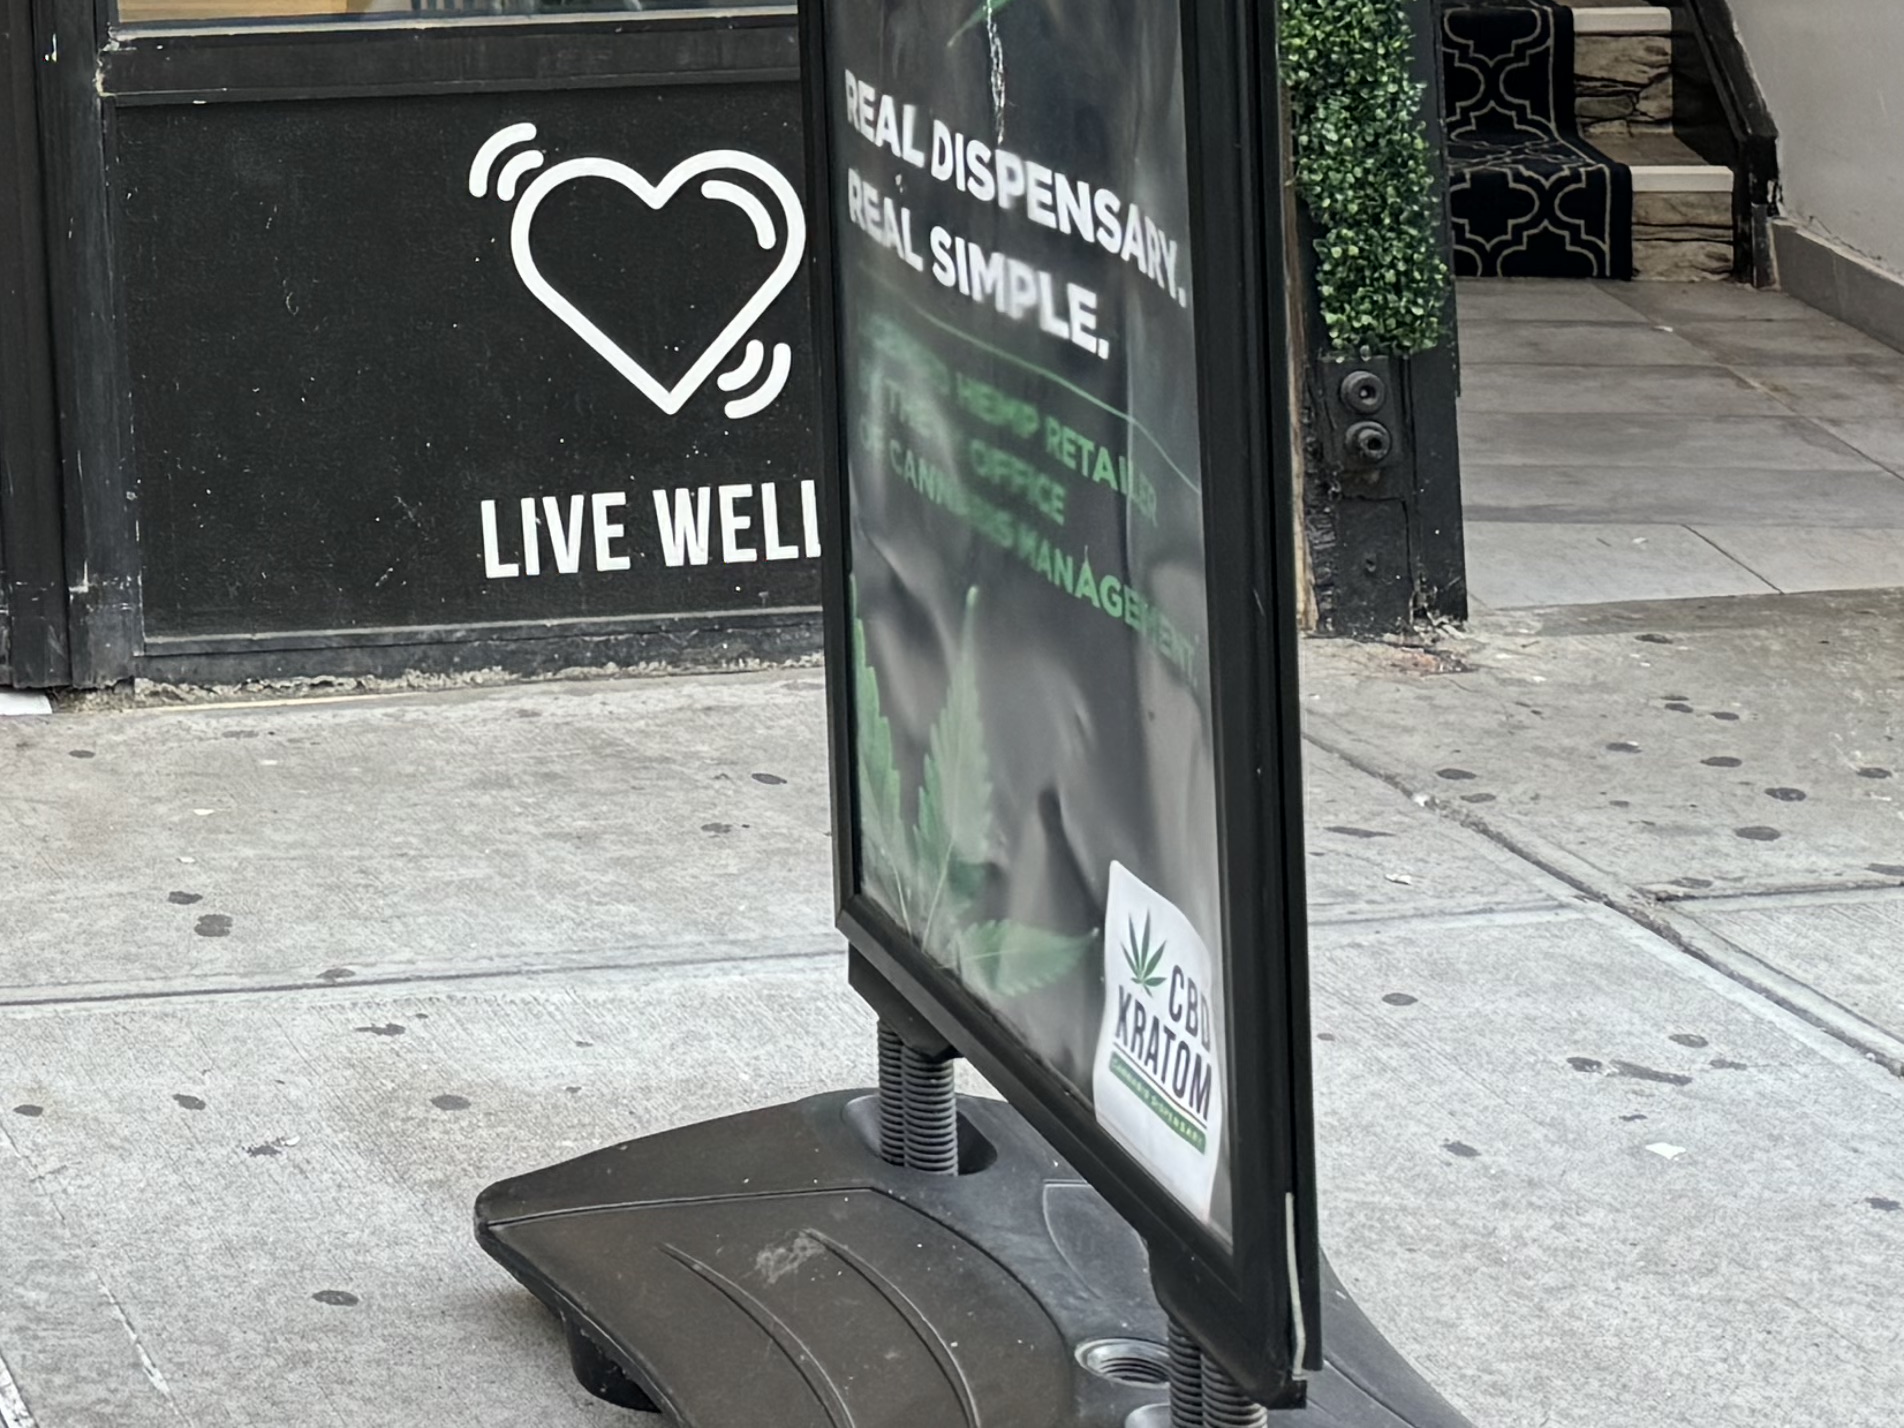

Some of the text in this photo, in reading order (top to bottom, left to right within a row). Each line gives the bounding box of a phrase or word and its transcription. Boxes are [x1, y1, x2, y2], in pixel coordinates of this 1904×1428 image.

[845, 68, 1187, 308] REAL DISPENSARY.
[848, 168, 924, 272] REAL
[930, 226, 1110, 360] SIMPLE.
[480, 491, 631, 580] LIVE
[1114, 984, 1212, 1121] KRATOM
[1168, 964, 1211, 1053] CBD
